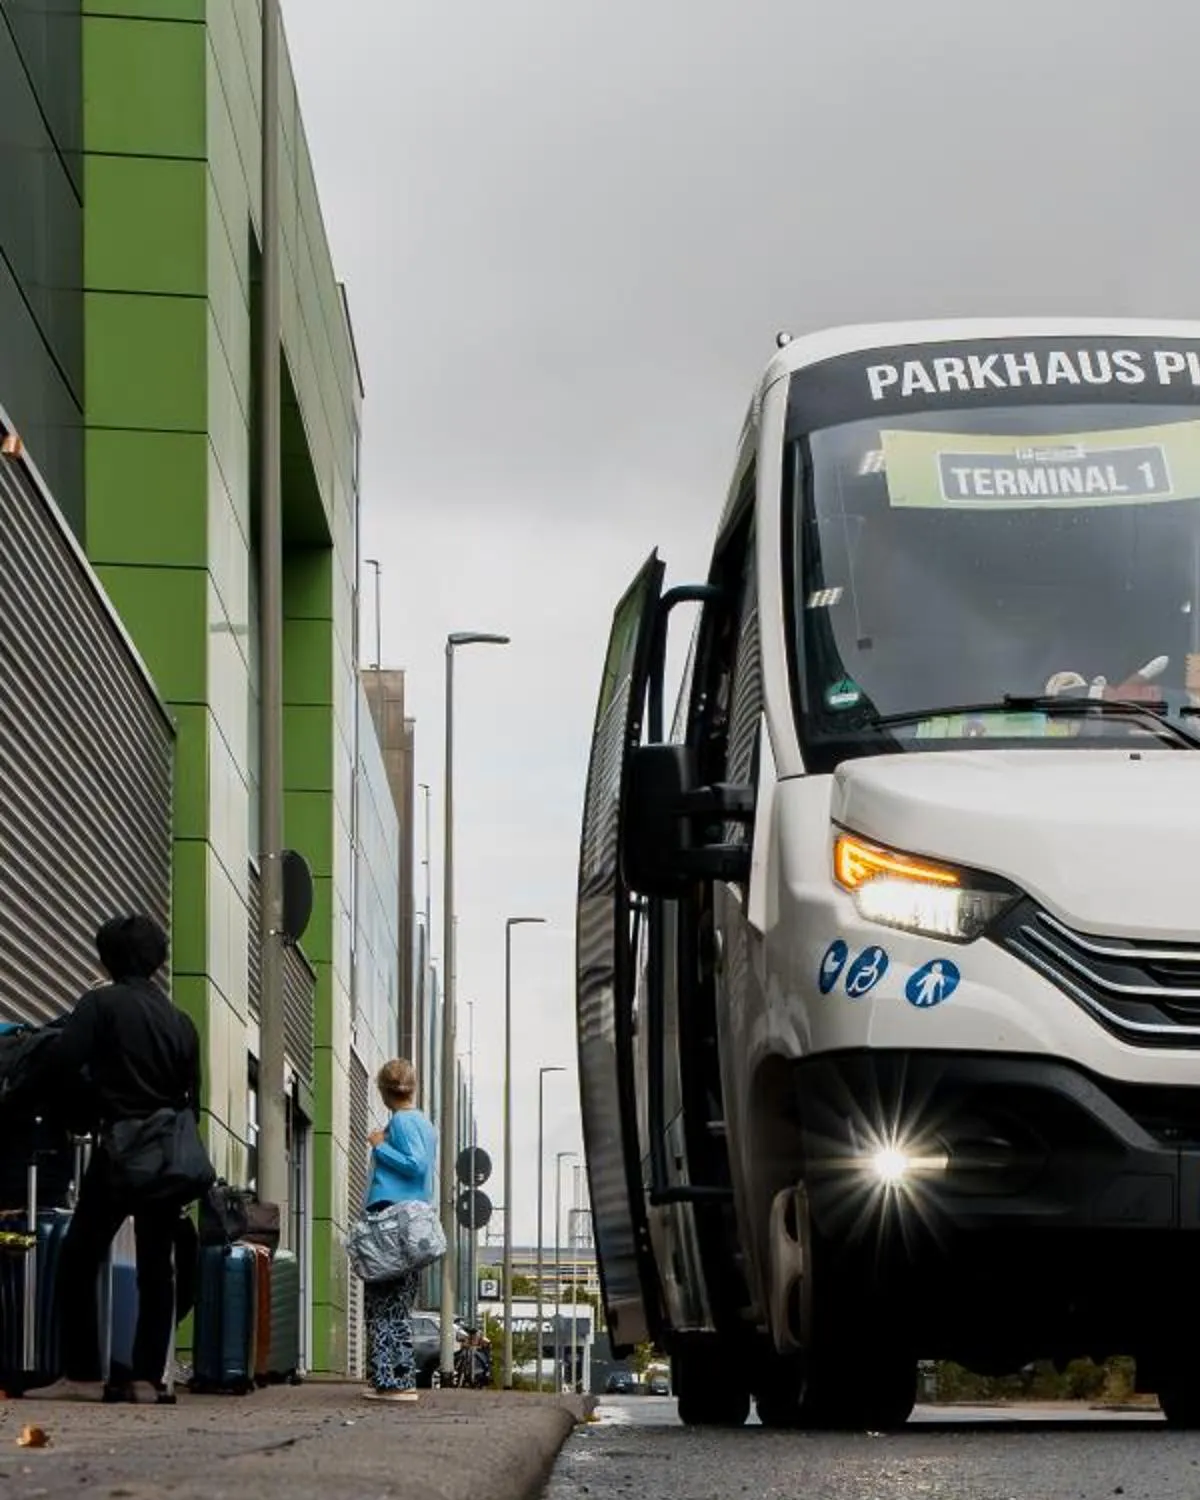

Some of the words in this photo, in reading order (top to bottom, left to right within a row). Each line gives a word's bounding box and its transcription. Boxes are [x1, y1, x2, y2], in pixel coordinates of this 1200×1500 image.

[865, 350, 1146, 400] PARKHAUS
[950, 465, 1129, 496] TERMINAL
[1138, 461, 1157, 489] 1
